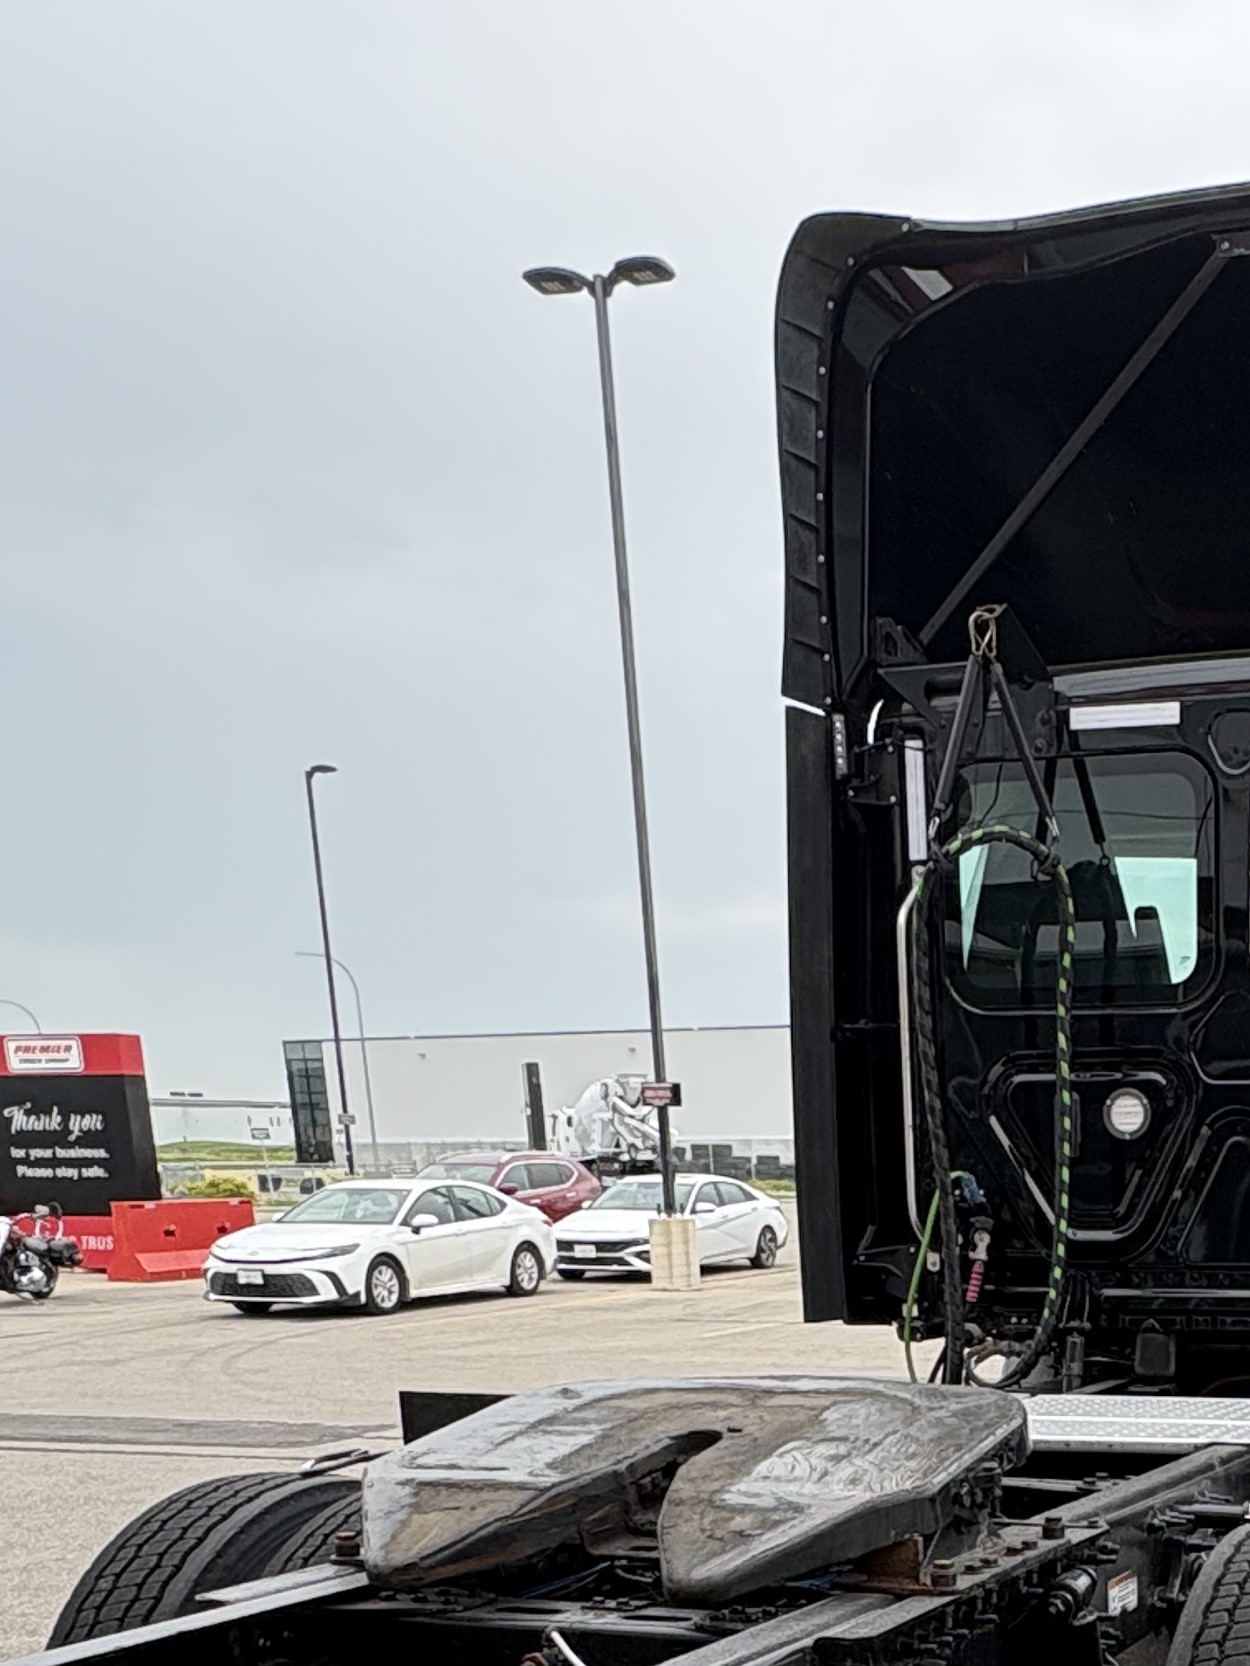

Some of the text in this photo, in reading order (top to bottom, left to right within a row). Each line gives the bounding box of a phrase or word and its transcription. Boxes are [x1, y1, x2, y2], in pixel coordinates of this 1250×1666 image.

[3, 1101, 104, 1141] Thank you
[28, 1148, 54, 1160] your
[54, 1145, 110, 1158] business.
[16, 1165, 54, 1178] Please
